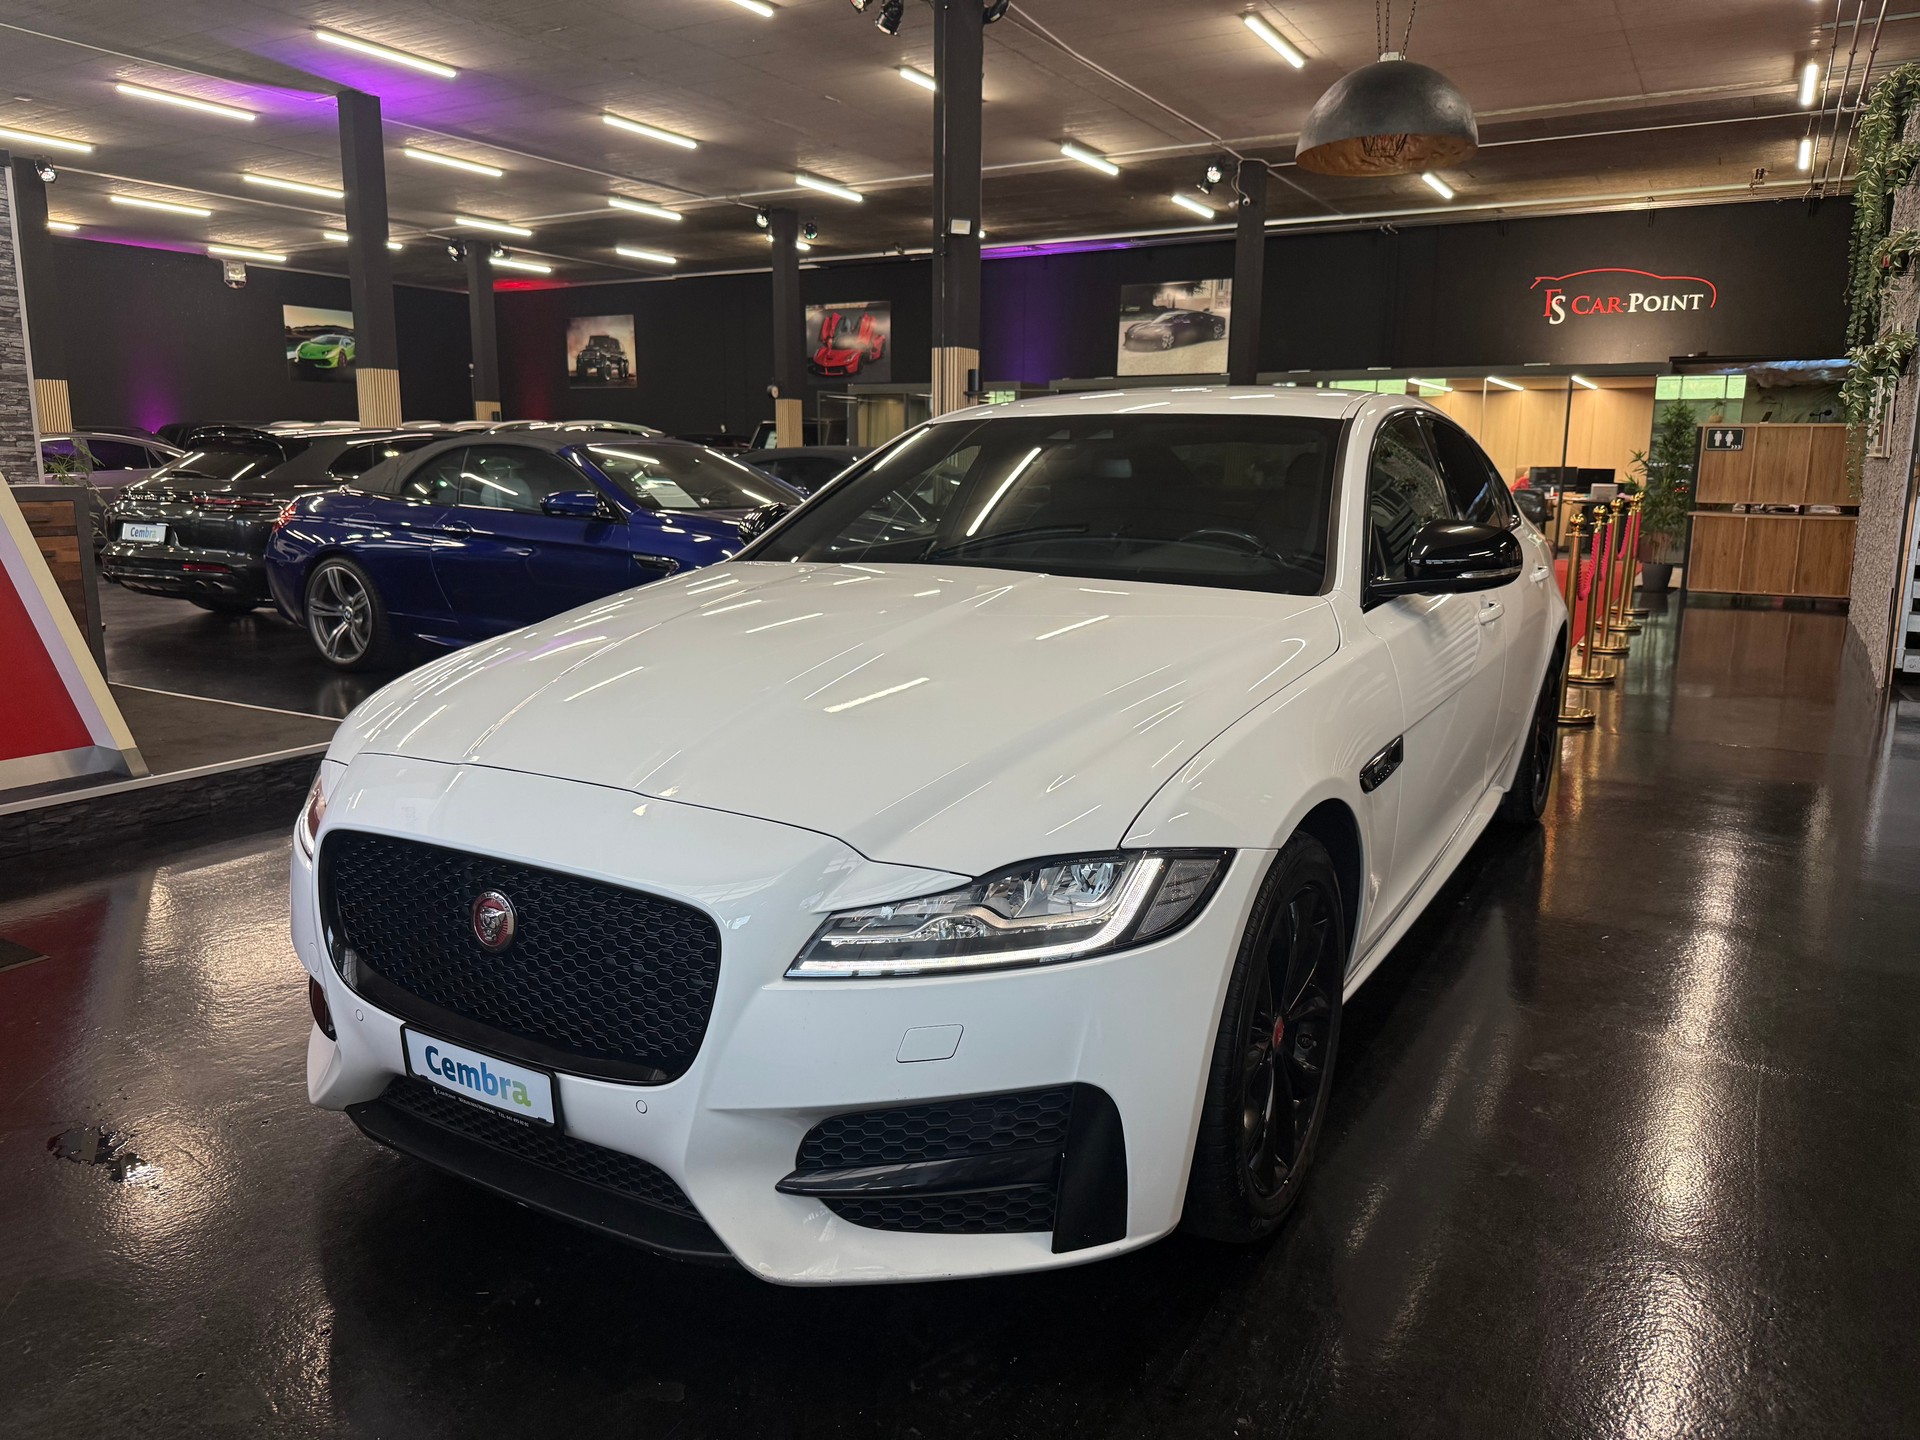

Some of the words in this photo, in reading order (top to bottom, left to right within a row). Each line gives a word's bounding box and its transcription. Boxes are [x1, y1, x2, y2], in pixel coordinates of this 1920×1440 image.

[1571, 293, 1704, 315] CAR-POINT
[130, 526, 157, 539] Cembra
[425, 1045, 532, 1107] Cembra
